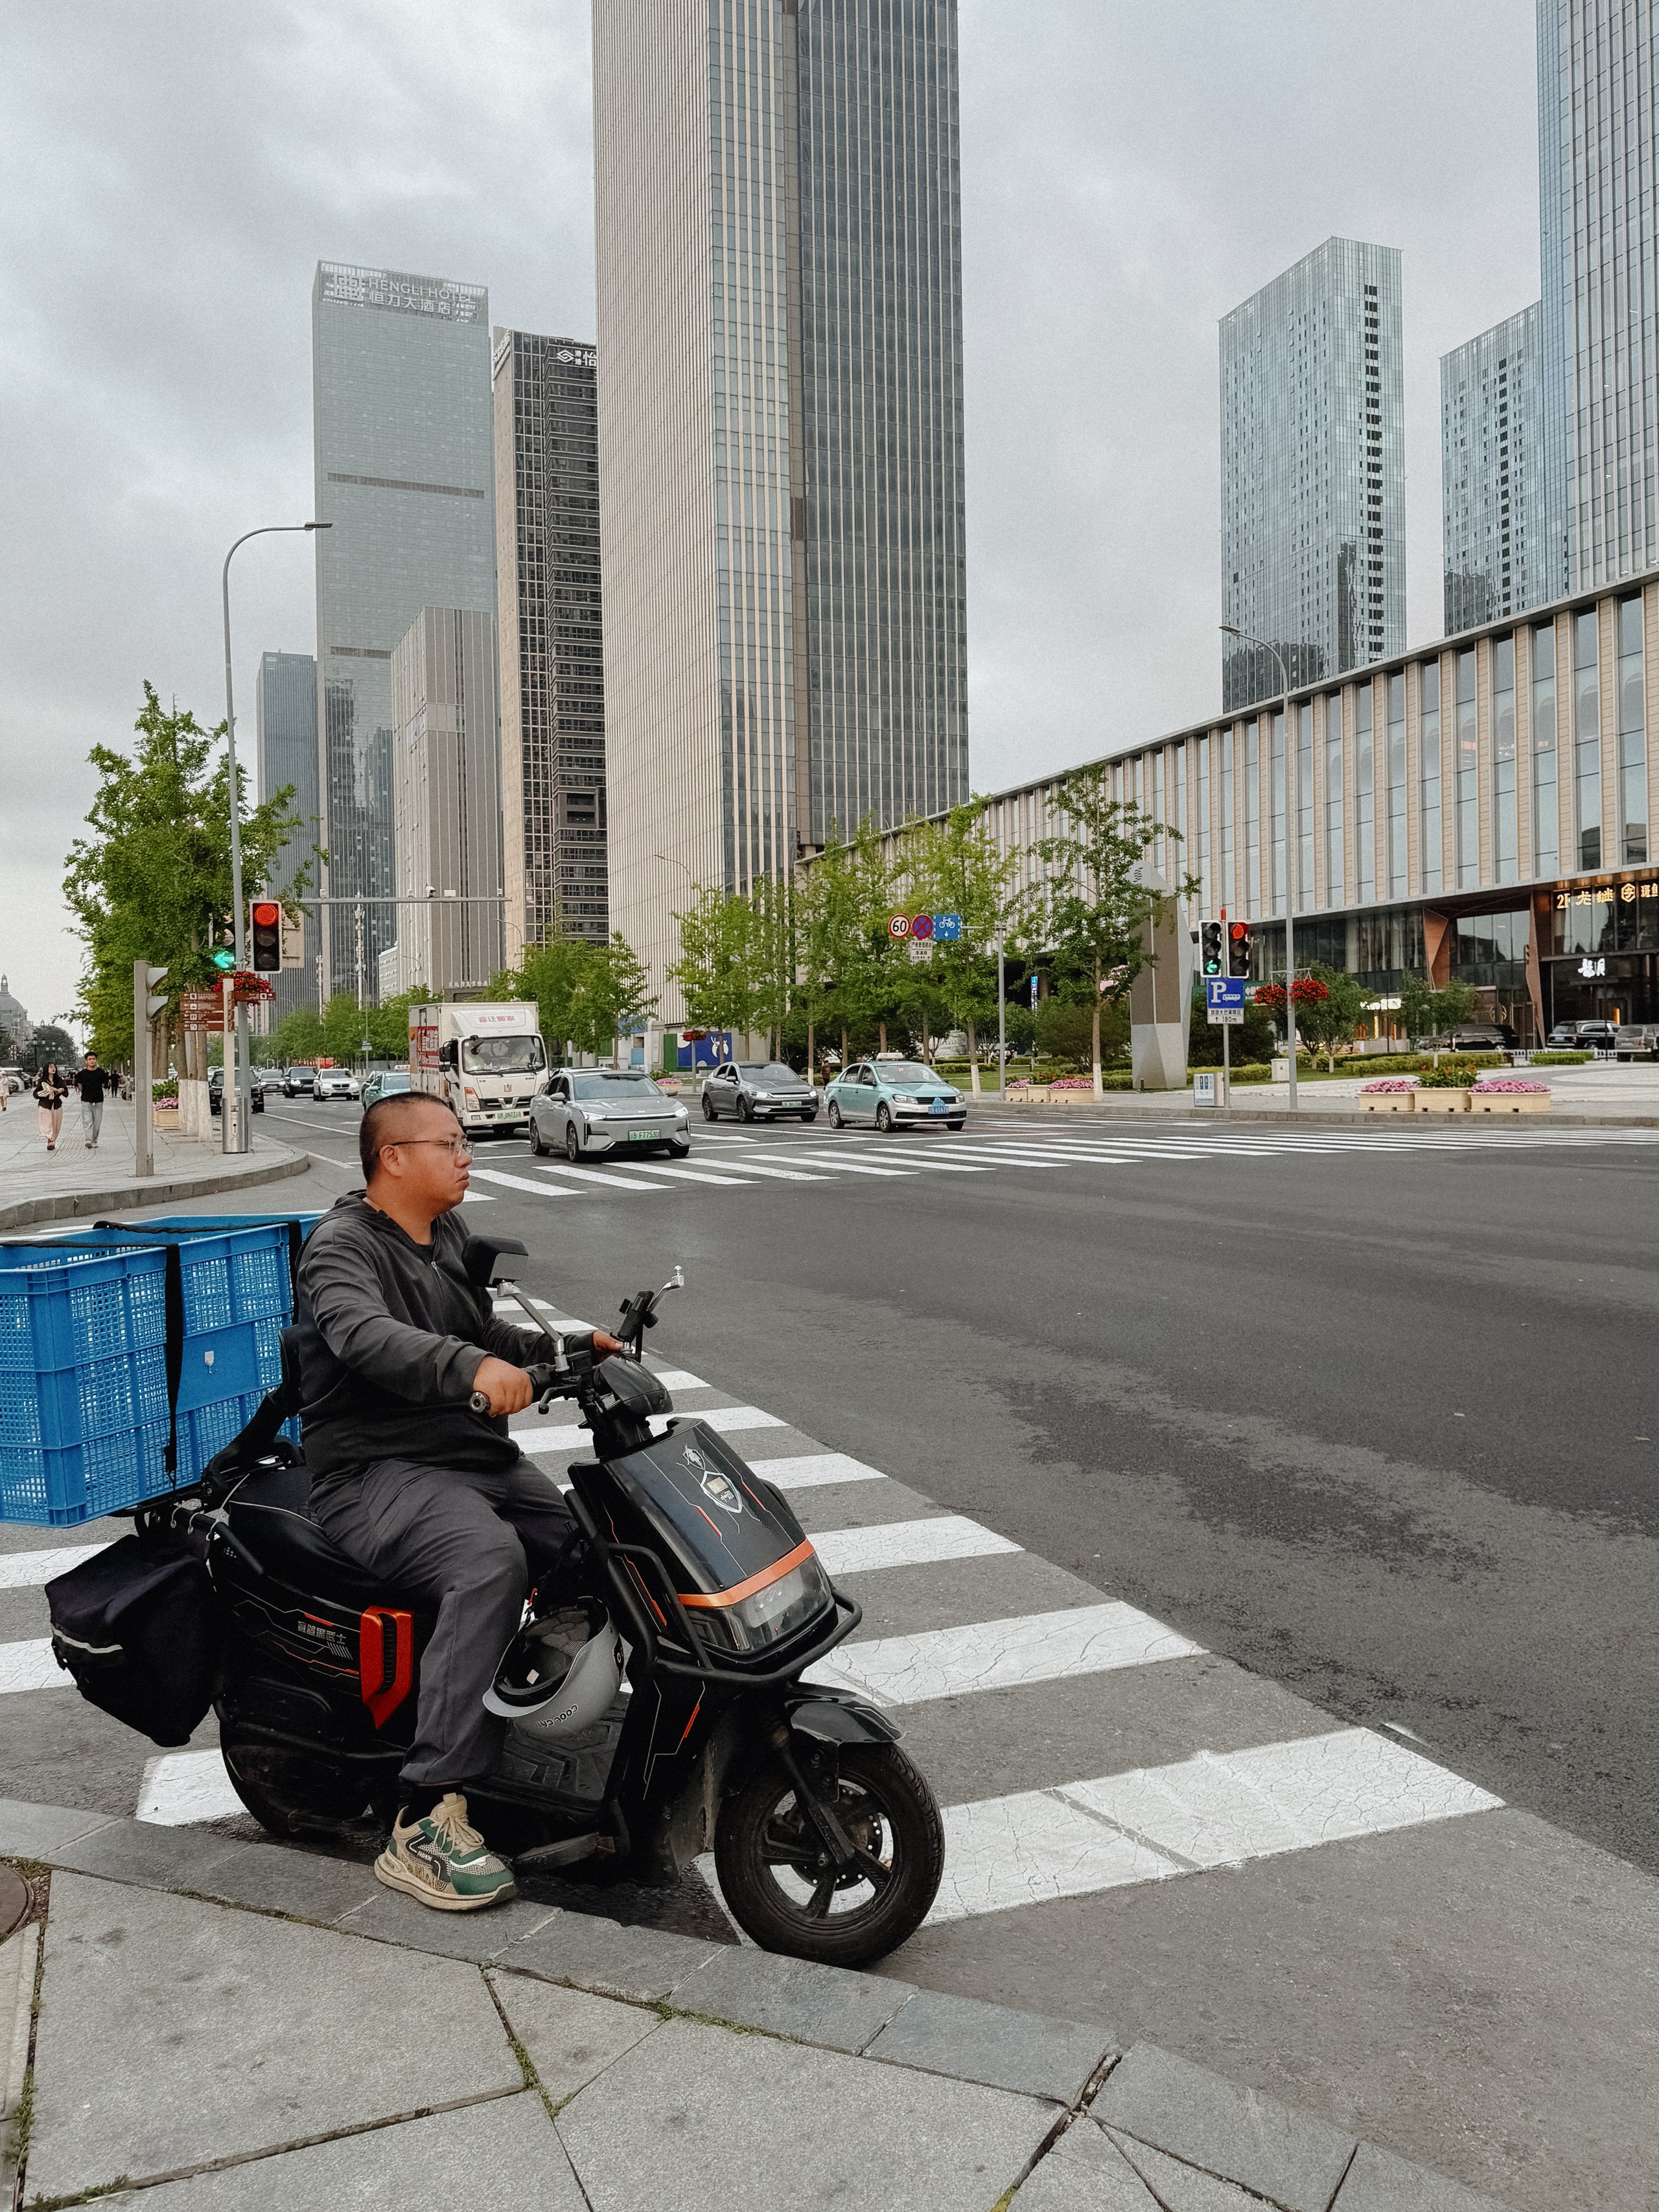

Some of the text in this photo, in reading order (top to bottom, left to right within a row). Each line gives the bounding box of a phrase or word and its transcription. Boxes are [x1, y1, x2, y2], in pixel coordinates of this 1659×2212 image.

[369, 277, 476, 304] HENGLI HOTEL
[369, 292, 452, 316] 恒力大酒店
[892, 920, 907, 933] 60
[1211, 981, 1227, 1003] P
[639, 1130, 659, 1139] F77530
[553, 1704, 579, 1723] COOL
